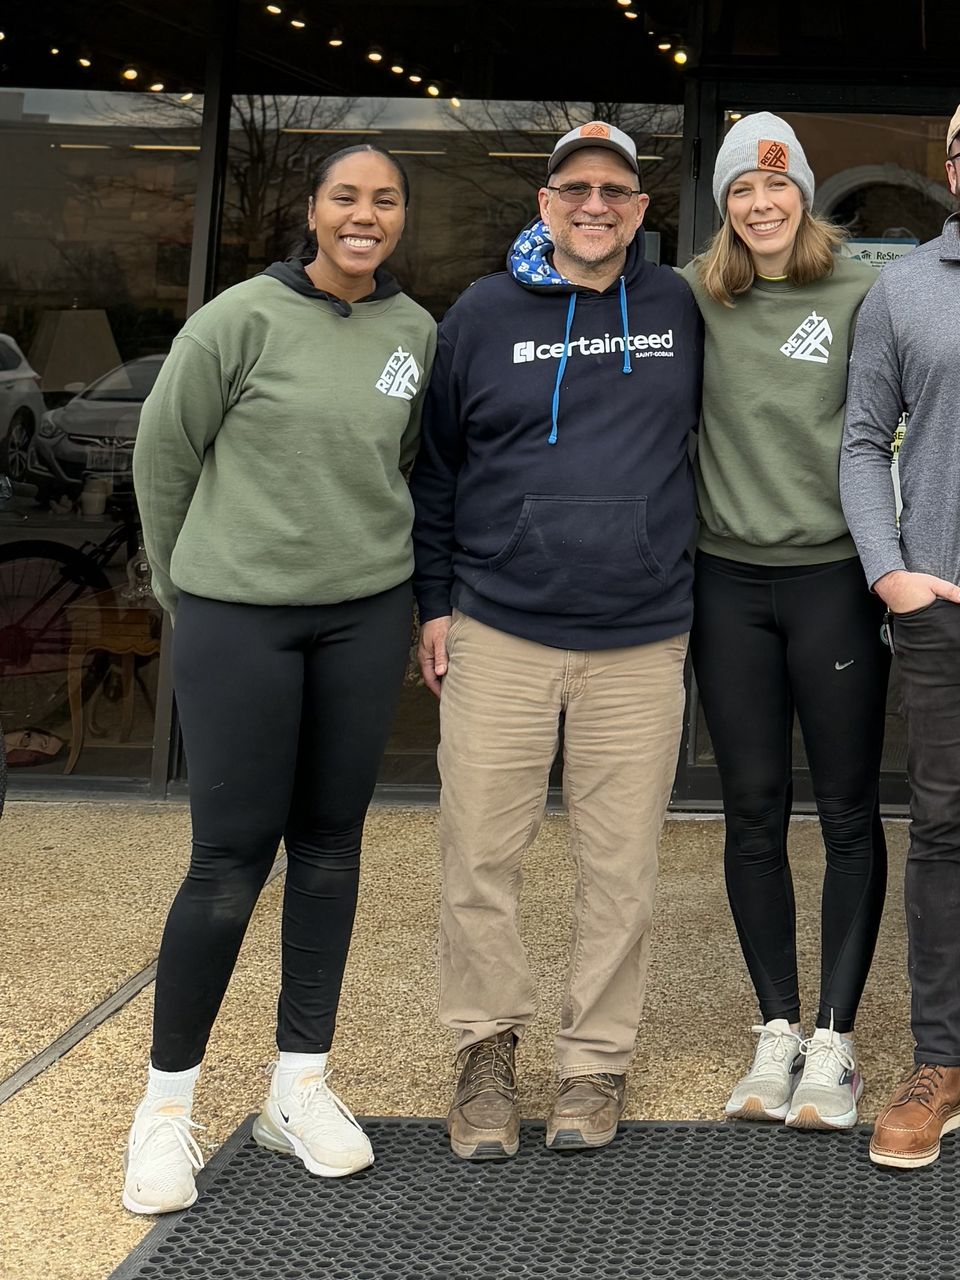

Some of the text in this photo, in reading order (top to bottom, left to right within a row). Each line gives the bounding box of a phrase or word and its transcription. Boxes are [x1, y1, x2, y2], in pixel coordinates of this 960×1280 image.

[760, 141, 780, 166] RETEX
[876, 251, 903, 261] ReSto
[535, 329, 674, 360] certainteed
[779, 310, 824, 358] RETEX
[375, 345, 410, 396] RETEX
